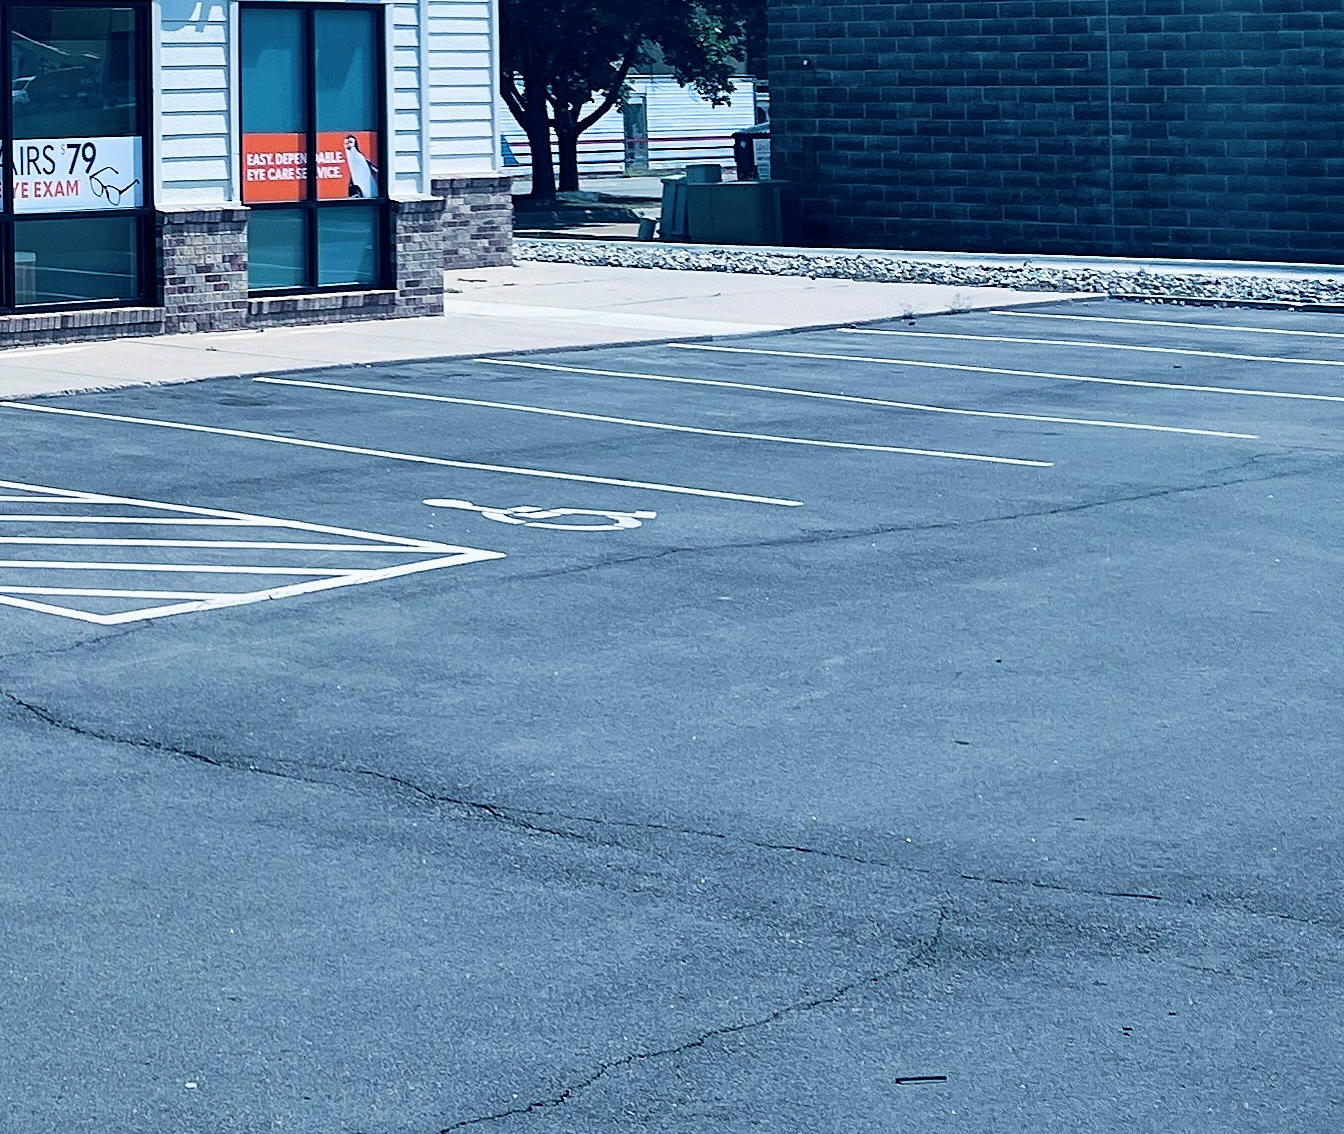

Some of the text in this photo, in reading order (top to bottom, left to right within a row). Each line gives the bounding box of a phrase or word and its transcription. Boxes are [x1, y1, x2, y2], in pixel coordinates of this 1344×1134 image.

[60, 142, 97, 175] $79
[246, 151, 346, 166] EASY. DEPENABLE.
[246, 166, 343, 181] EYE CARE SEVICE.
